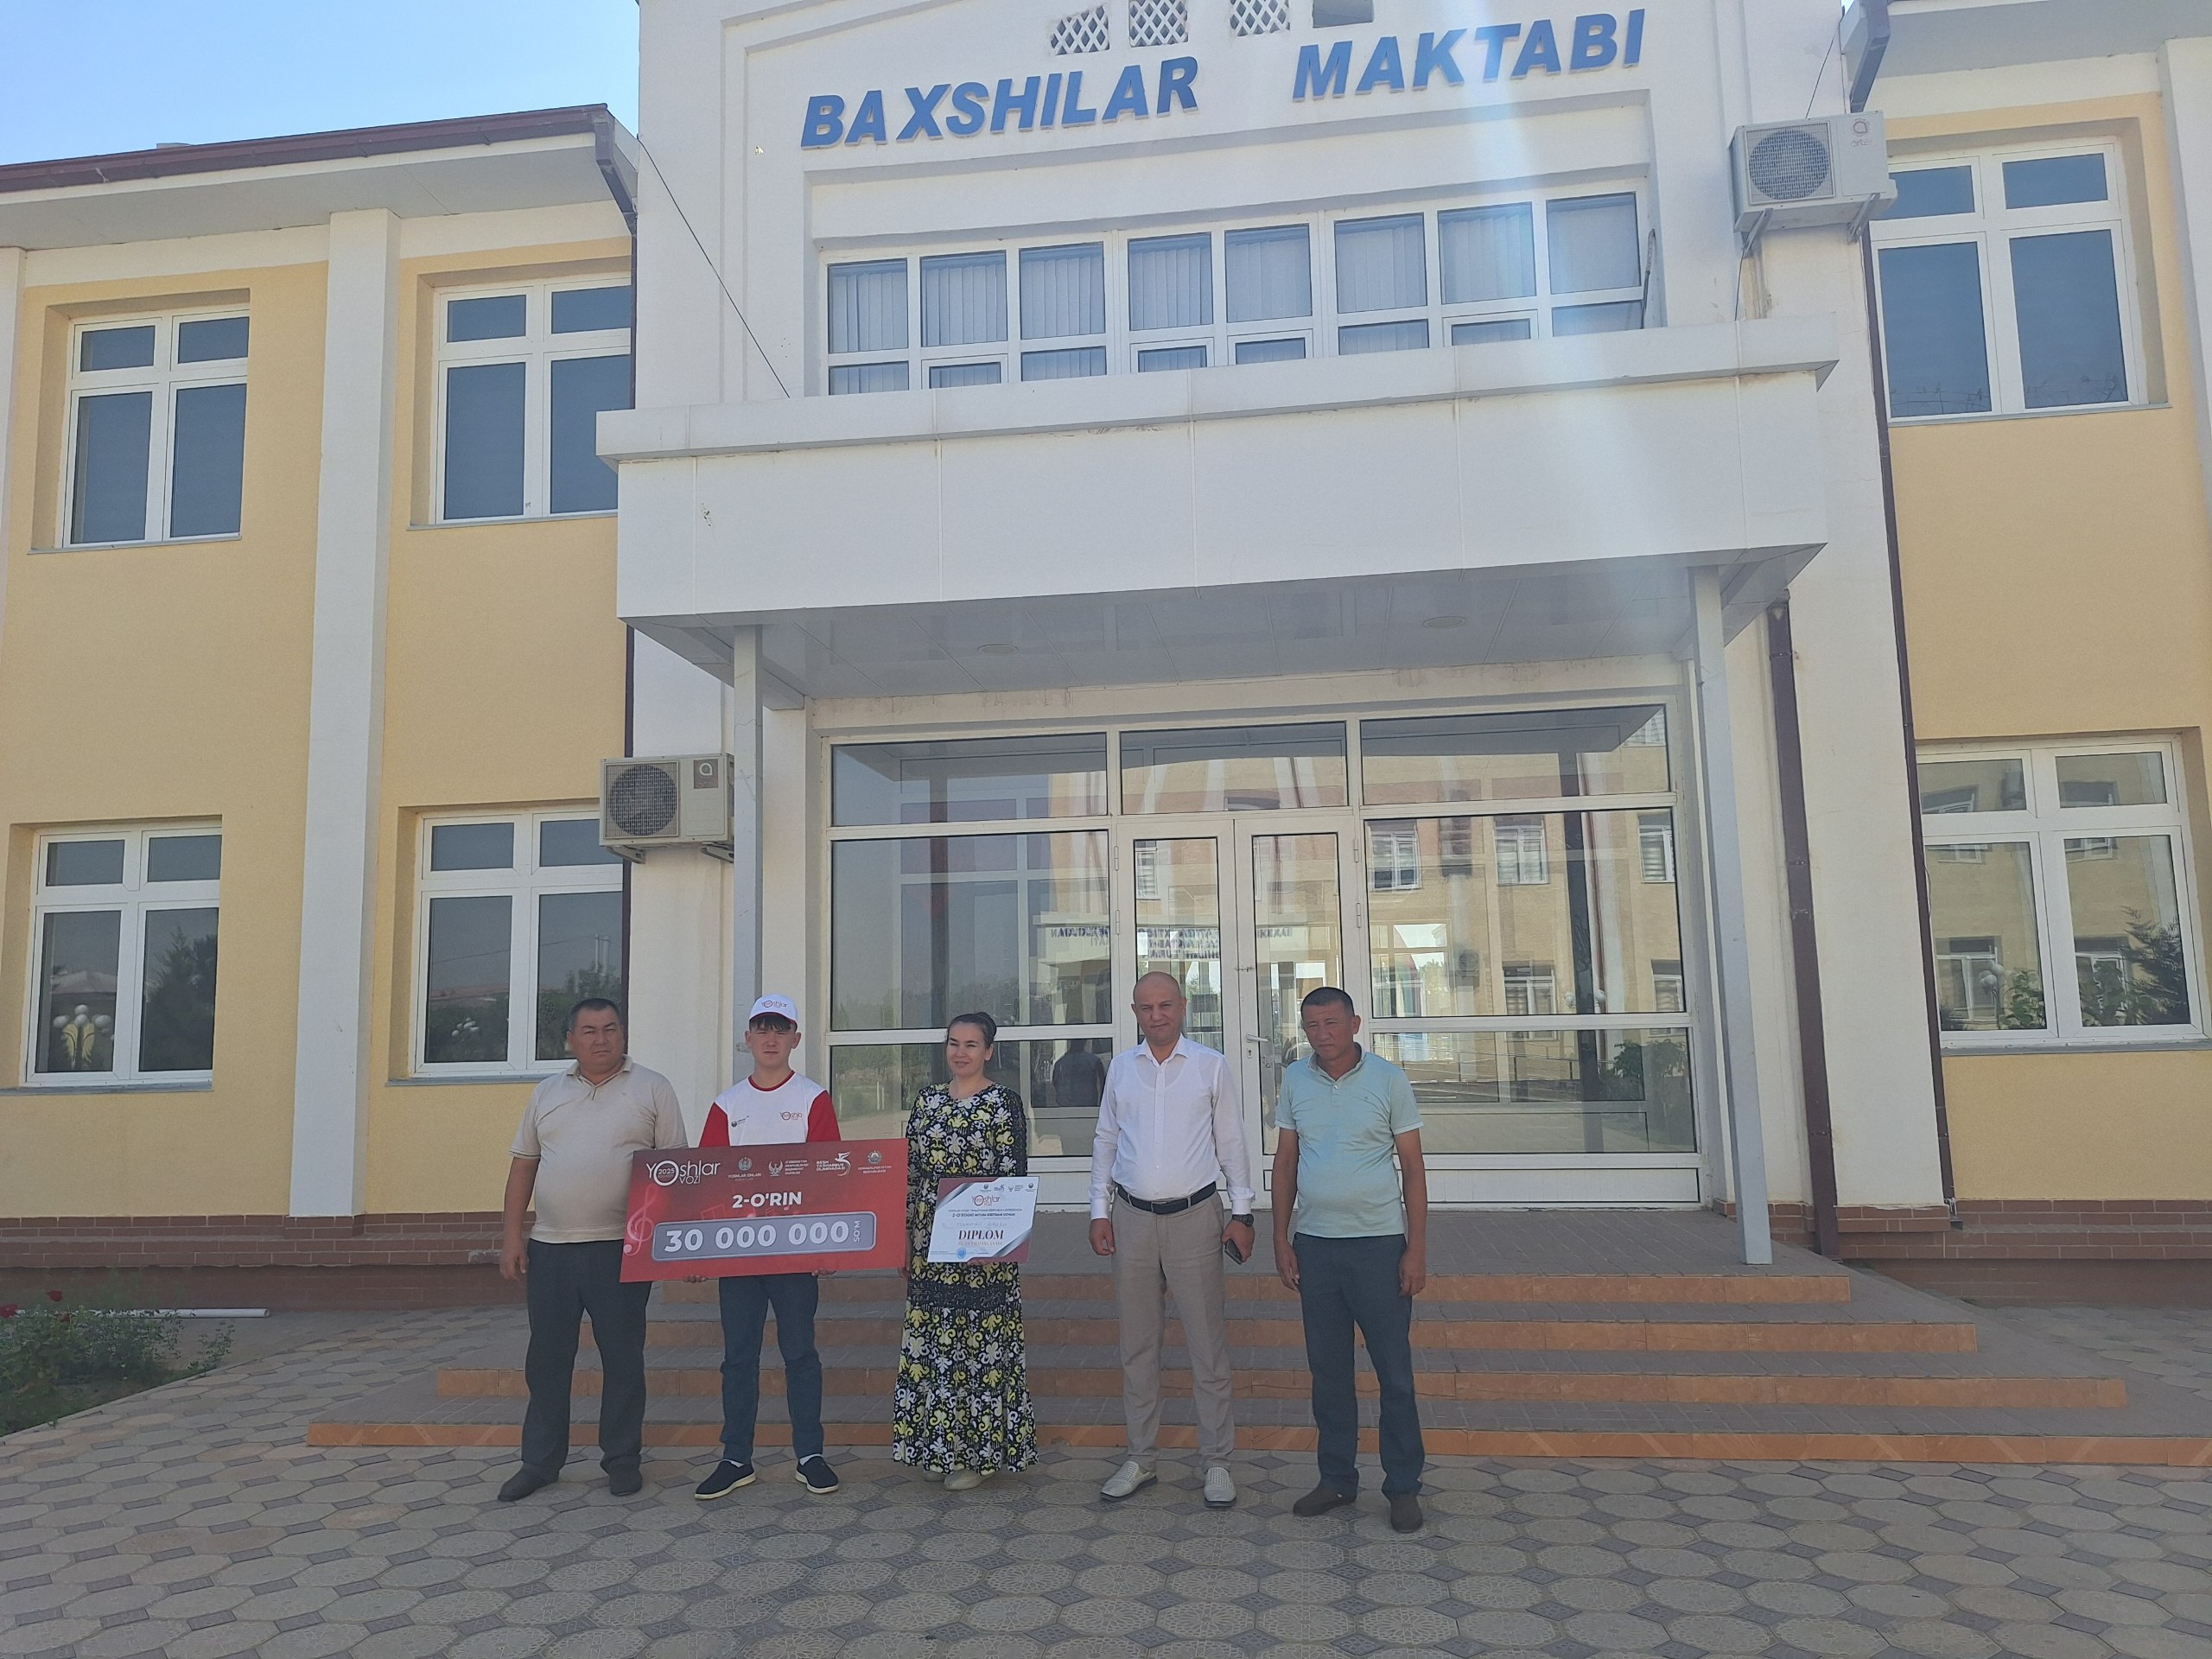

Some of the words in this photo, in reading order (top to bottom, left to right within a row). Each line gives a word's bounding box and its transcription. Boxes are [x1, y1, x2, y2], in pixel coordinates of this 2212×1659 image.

[801, 57, 1199, 148] BAXSHILAR
[1293, 10, 1647, 102] MAKTABI
[732, 1191, 803, 1209] 2-O'RIN
[664, 1229, 703, 1252] 30
[715, 1224, 777, 1249] 000
[788, 1220, 849, 1245] 000
[958, 1230, 1004, 1240] DIPLOM
